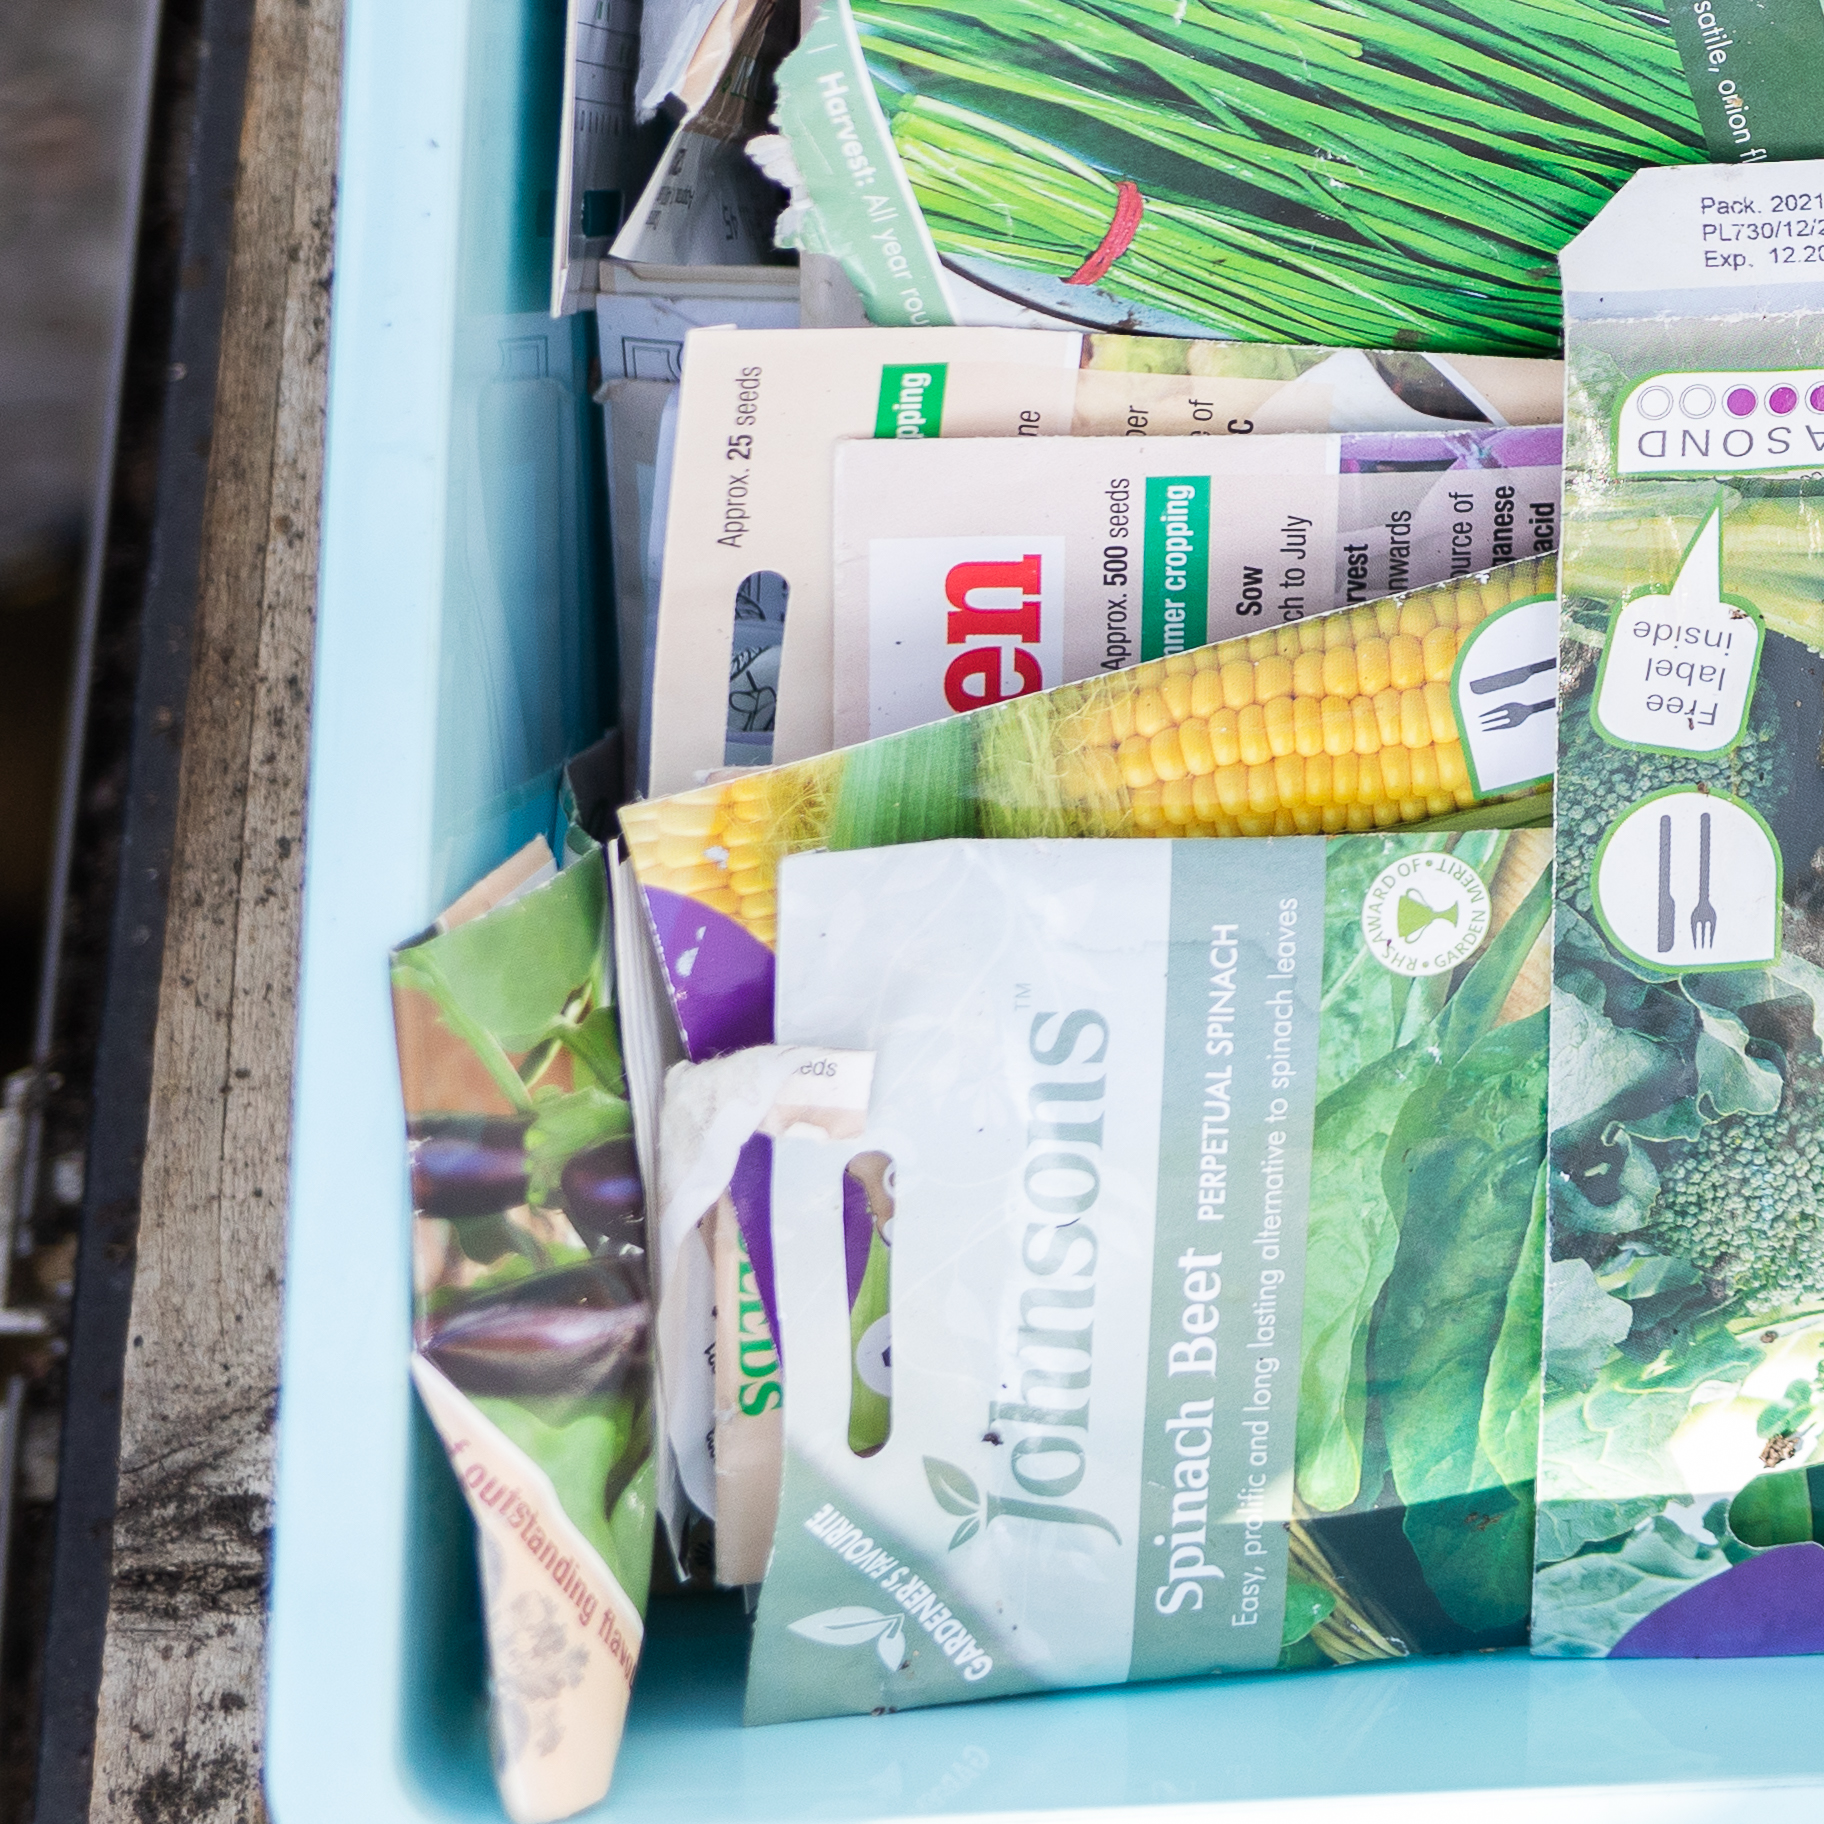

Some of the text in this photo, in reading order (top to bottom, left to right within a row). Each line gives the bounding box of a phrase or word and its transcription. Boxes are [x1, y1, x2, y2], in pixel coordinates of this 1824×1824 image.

[1718, 79, 1751, 144] onion
[818, 69, 914, 286] Harvest: All year
[1700, 193, 1824, 217] Pack. 2021
[1705, 248, 1754, 271] Exp.
[1189, 398, 1213, 421] of
[717, 366, 761, 548] Approx. 25 seeds
[1448, 491, 1474, 513] of
[1157, 485, 1196, 591] cropping
[1279, 515, 1313, 589] to July
[1528, 501, 1556, 552] acid
[1099, 478, 1133, 671] Approx. 500 seeds
[1235, 565, 1263, 616] Sow
[1632, 621, 1734, 650] inside
[1645, 658, 1725, 692] label
[1645, 692, 1720, 727] Free
[1367, 858, 1420, 970] RHS AWARD OF
[1434, 858, 1485, 967] GARDEN MERIT
[983, 1008, 1123, 1545] Johnsons
[1153, 924, 1241, 1617] Spinach Beet PERPETUAL SPINACH
[1232, 897, 1299, 1626] Easy, prolific and long lasting alternative to spinach leaves
[459, 1449, 611, 1627] outstanding
[806, 1496, 994, 1687] GARDENER'S FAVOURITE
